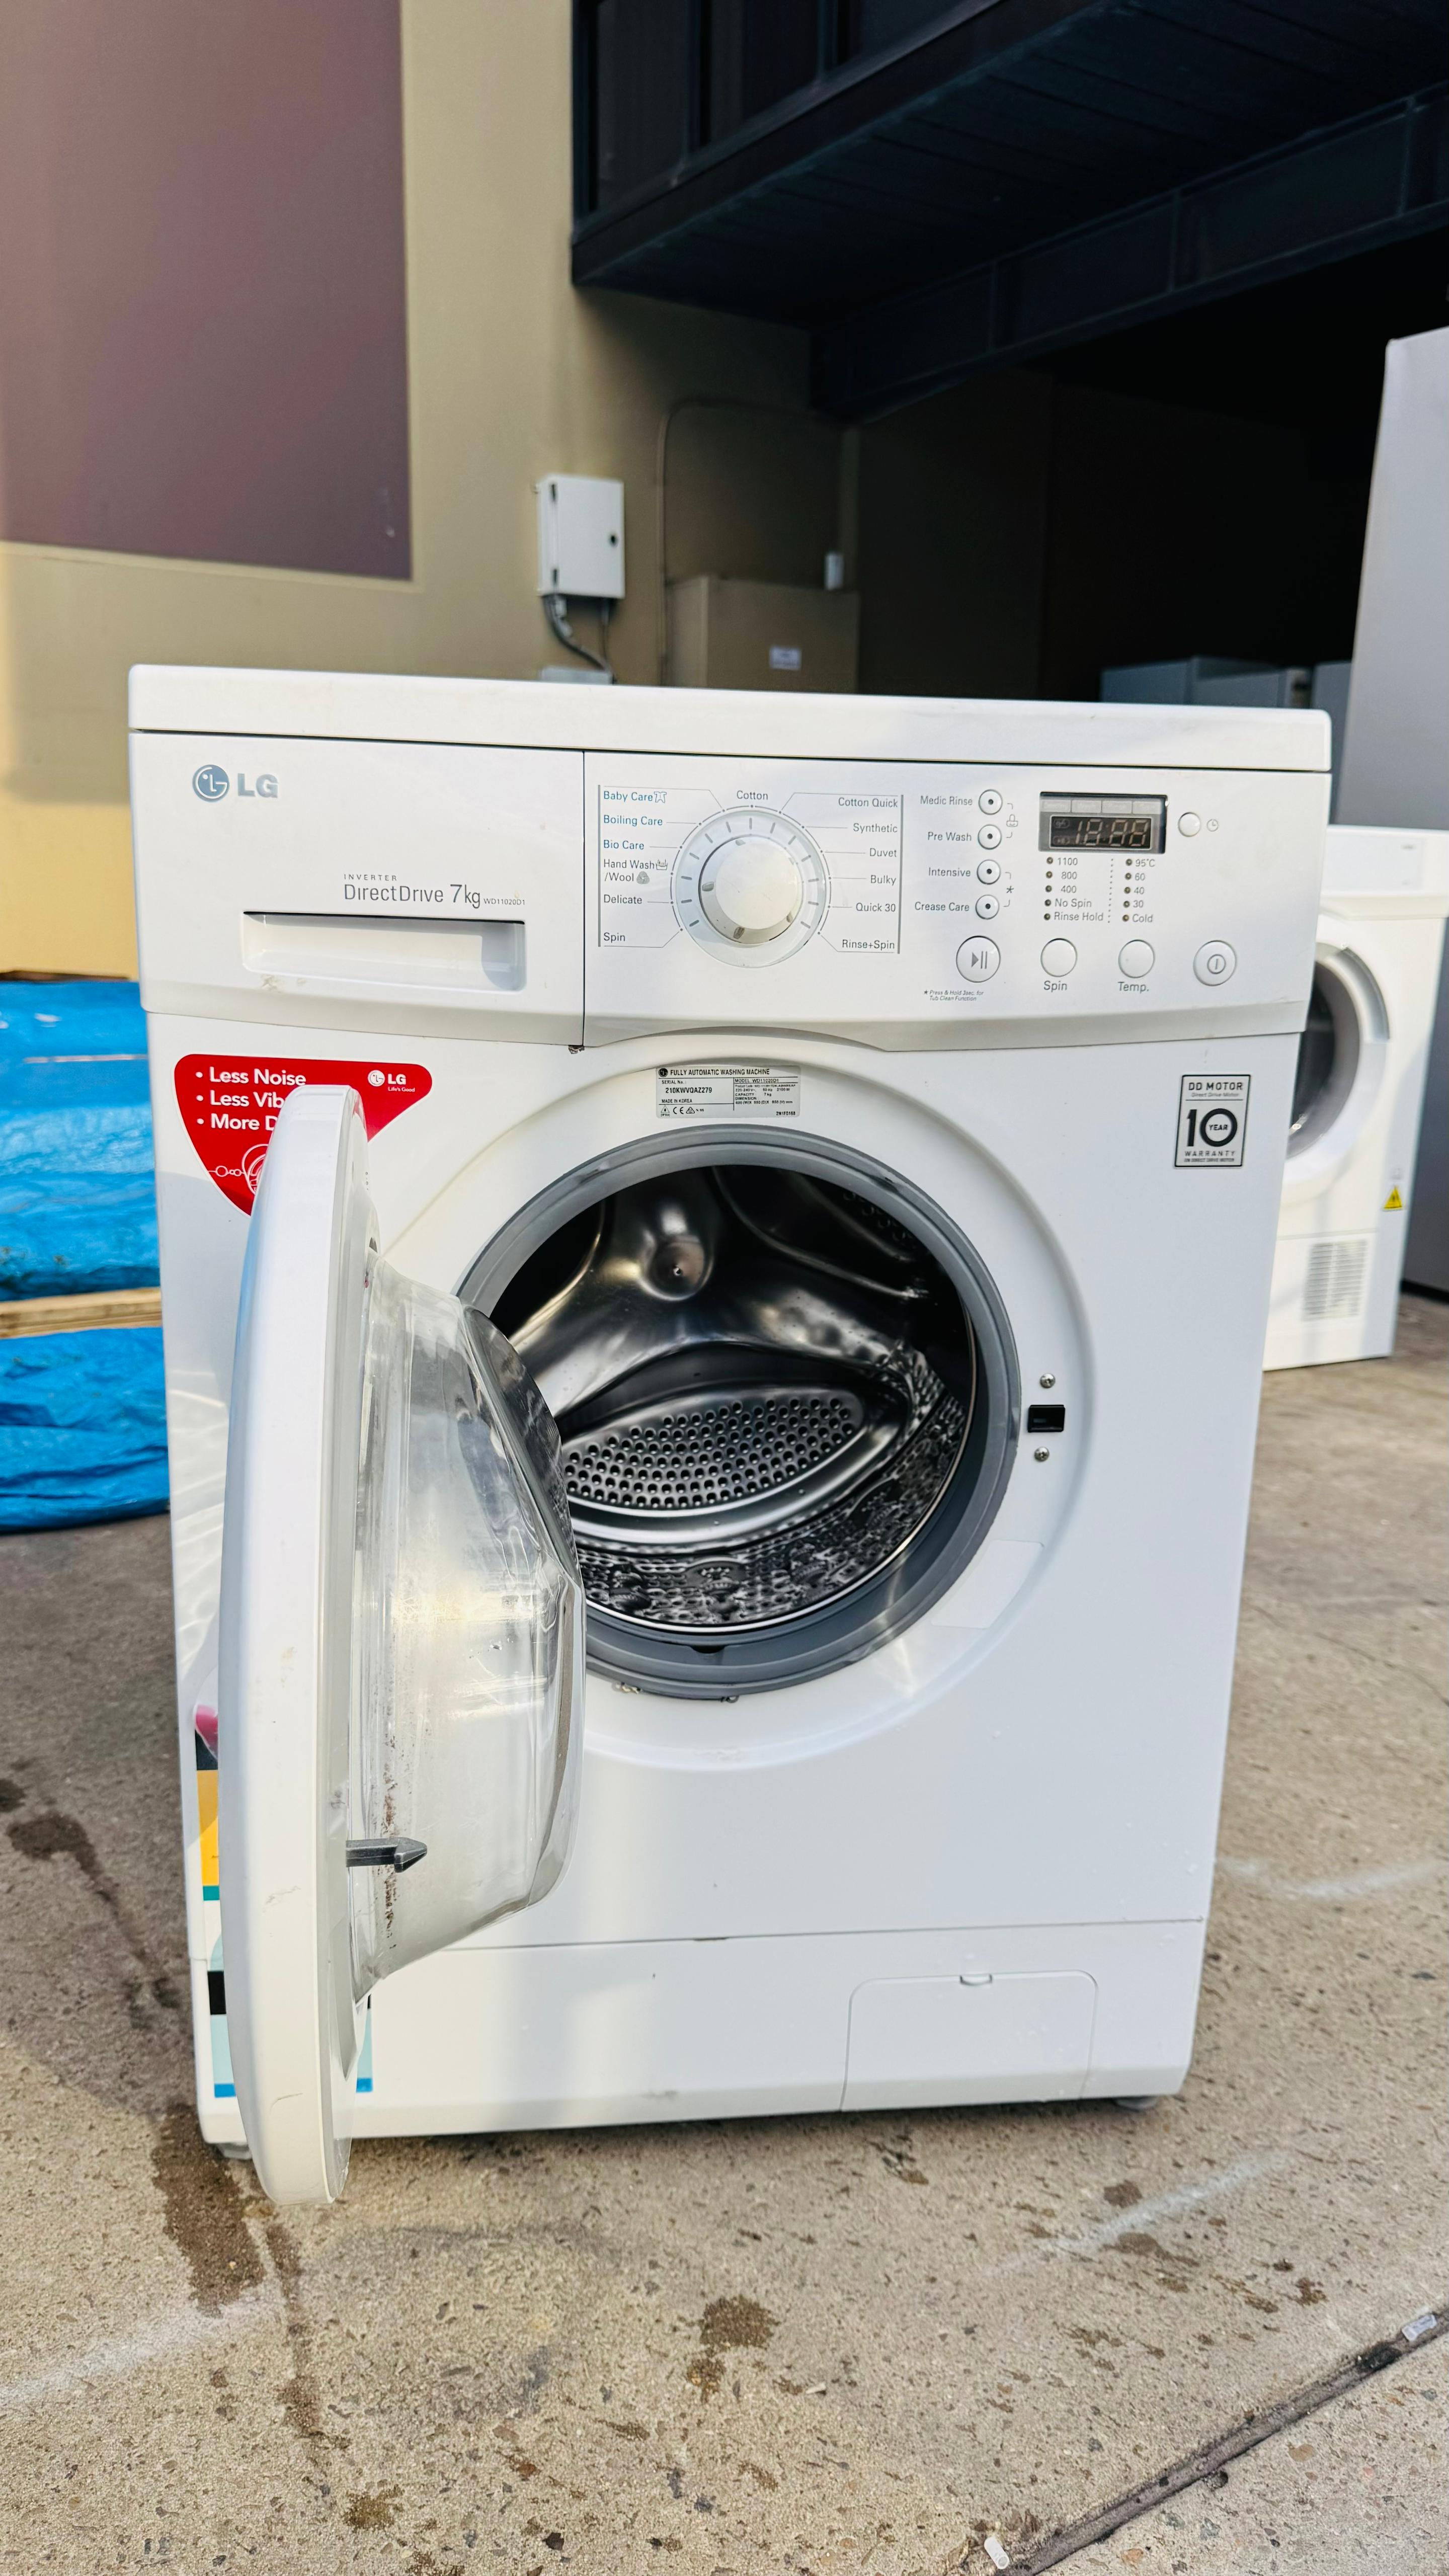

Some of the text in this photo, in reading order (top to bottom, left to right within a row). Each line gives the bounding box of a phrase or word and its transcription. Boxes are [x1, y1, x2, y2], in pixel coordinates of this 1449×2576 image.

[237, 773, 278, 798] LG
[604, 791, 653, 802] Baby Care
[737, 790, 768, 800] Cotton
[921, 795, 972, 805] Medic Rinse
[839, 797, 898, 807] Cotton Quick
[604, 815, 662, 827] Boiling Care
[853, 823, 897, 833] Synthetic
[928, 832, 971, 841] Pre Wash
[604, 840, 644, 849] Bio Care
[870, 848, 897, 857] Duvet
[604, 859, 654, 869] Hand Wash
[605, 872, 633, 881] /Wool
[929, 867, 971, 876] Intensive
[1061, 871, 1077, 879] 800
[871, 875, 896, 886] Bulky
[604, 895, 642, 904] Delicate
[1055, 899, 1091, 909] No Spin
[856, 903, 896, 912] Quick 30
[915, 902, 969, 911] Crease Care
[1055, 912, 1103, 921] Rinse Hold
[1133, 914, 1153, 922] Cold
[604, 932, 625, 943] Spin
[843, 939, 894, 950] Rinse+Spin
[1044, 981, 1067, 992] Spin
[1118, 982, 1149, 993] Temp.
[209, 1066, 306, 1086] Less Noise
[387, 1073, 407, 1085] LG
[1188, 1082, 1243, 1090] DD MOTOR
[210, 1090, 250, 1107] Less
[211, 1113, 260, 1131] More
